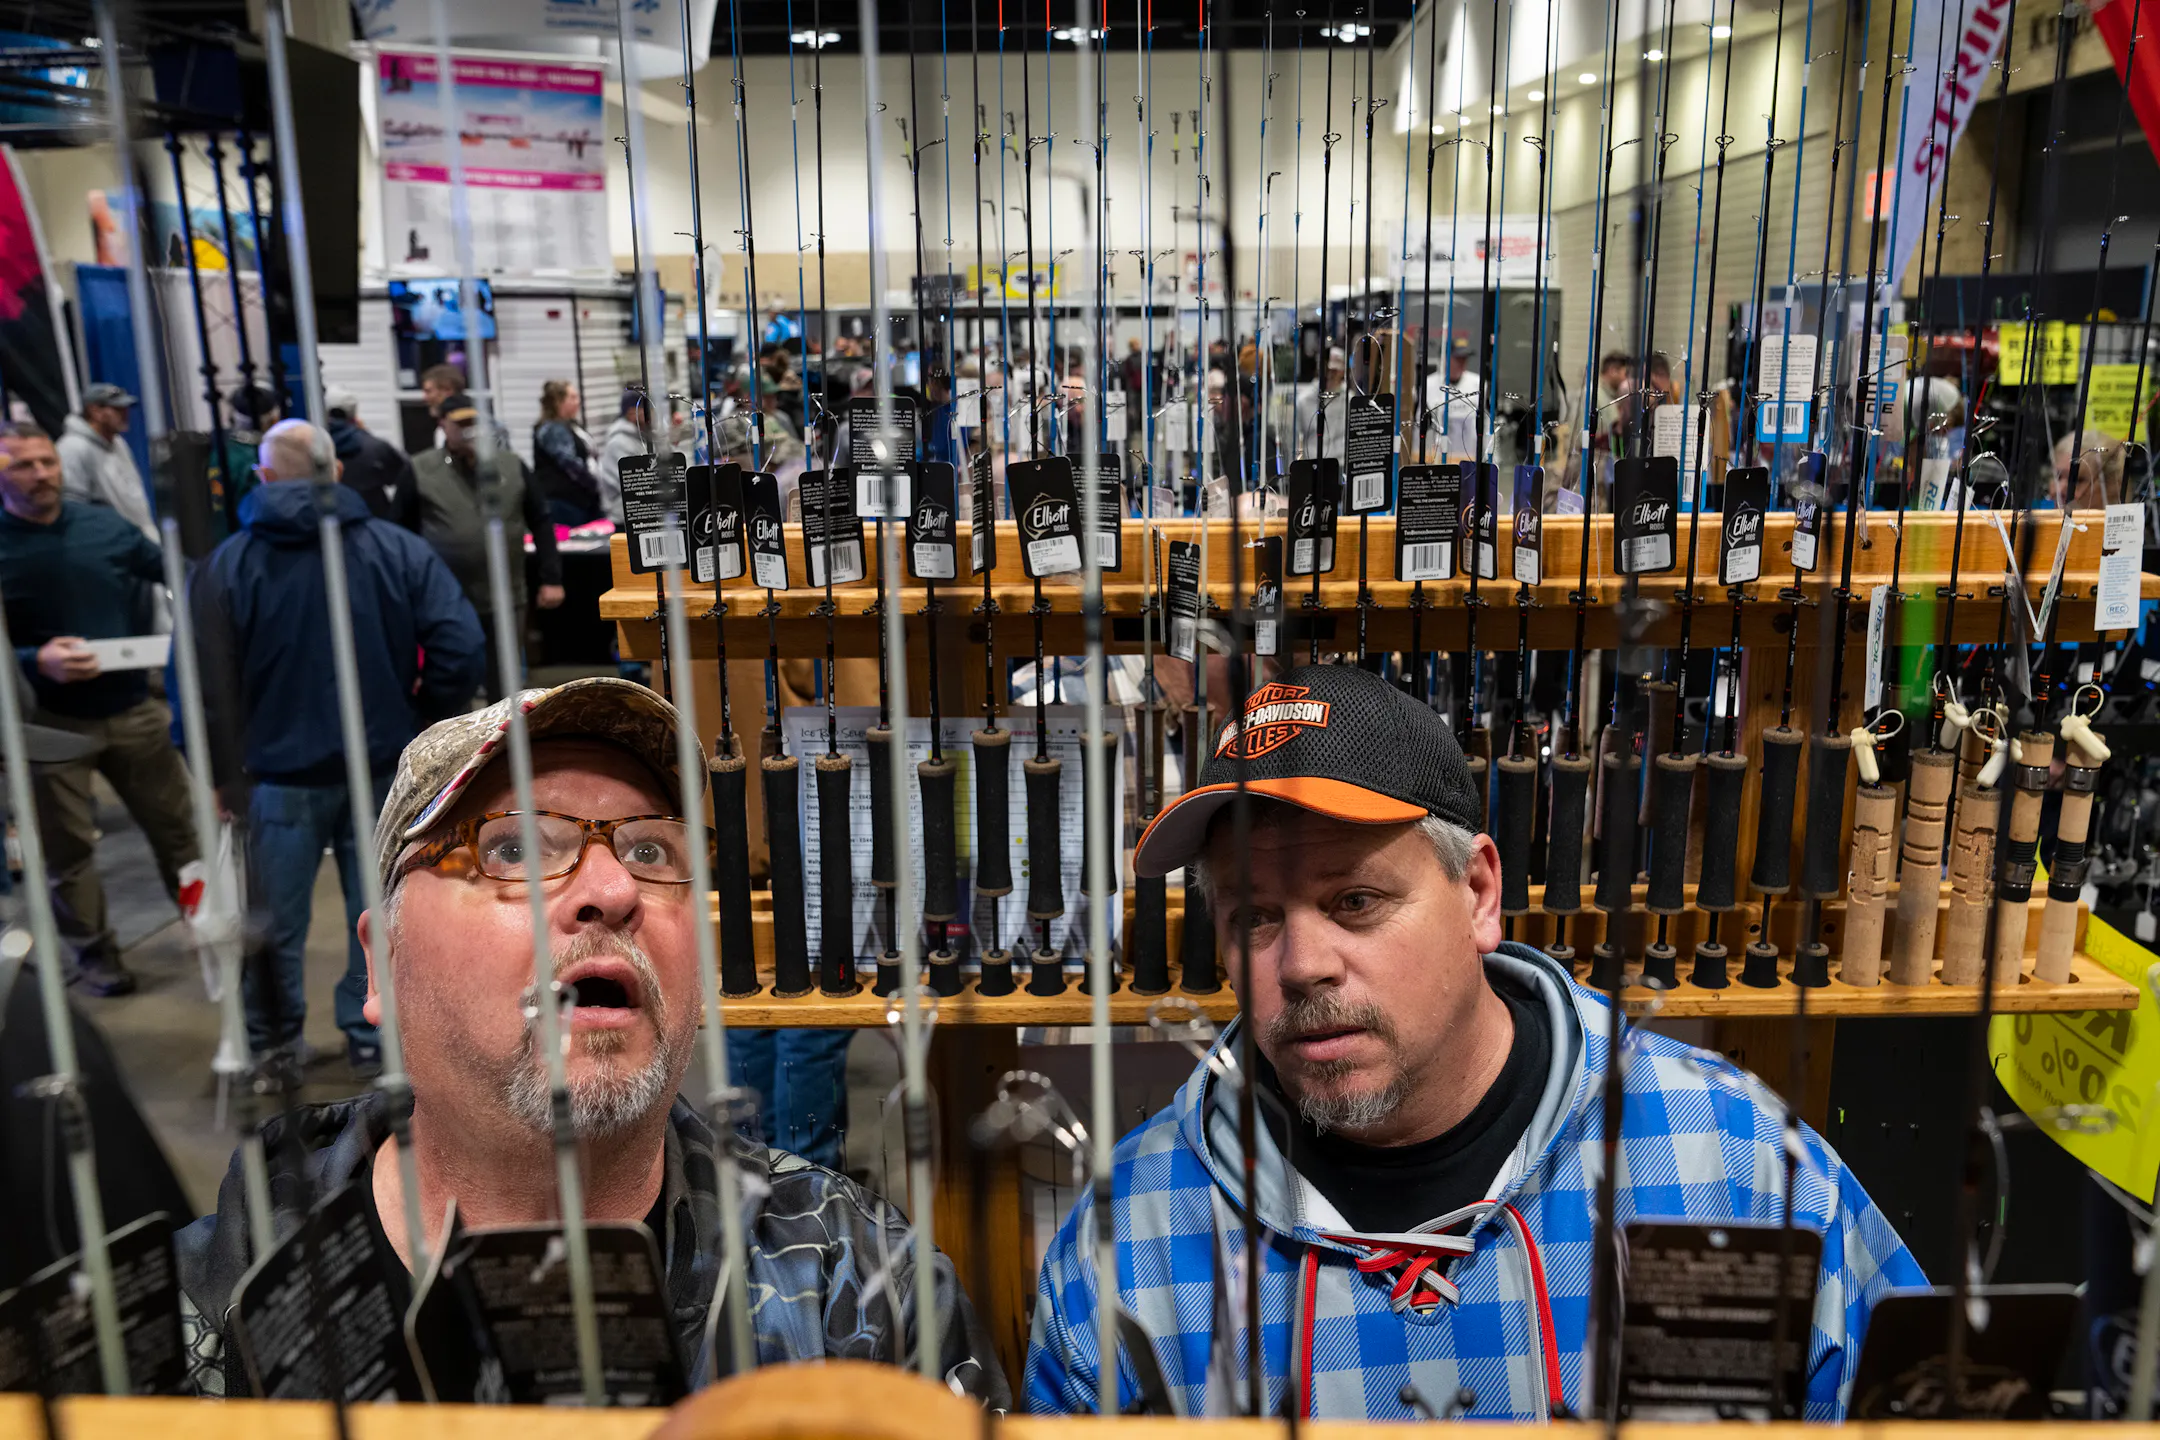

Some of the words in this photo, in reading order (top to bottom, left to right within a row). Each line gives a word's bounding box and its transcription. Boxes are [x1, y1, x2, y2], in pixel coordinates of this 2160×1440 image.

[918, 508, 949, 530] Elliott
[1033, 504, 1071, 528] Elliott
[1632, 503, 1670, 526] Elliott
[1797, 500, 1817, 520] Elliott
[756, 520, 779, 540] Elliott
[1053, 524, 1070, 532] RODS
[1520, 513, 1539, 533] Elliott
[1649, 523, 1665, 531] RODS
[1733, 514, 1760, 536] Elliott
